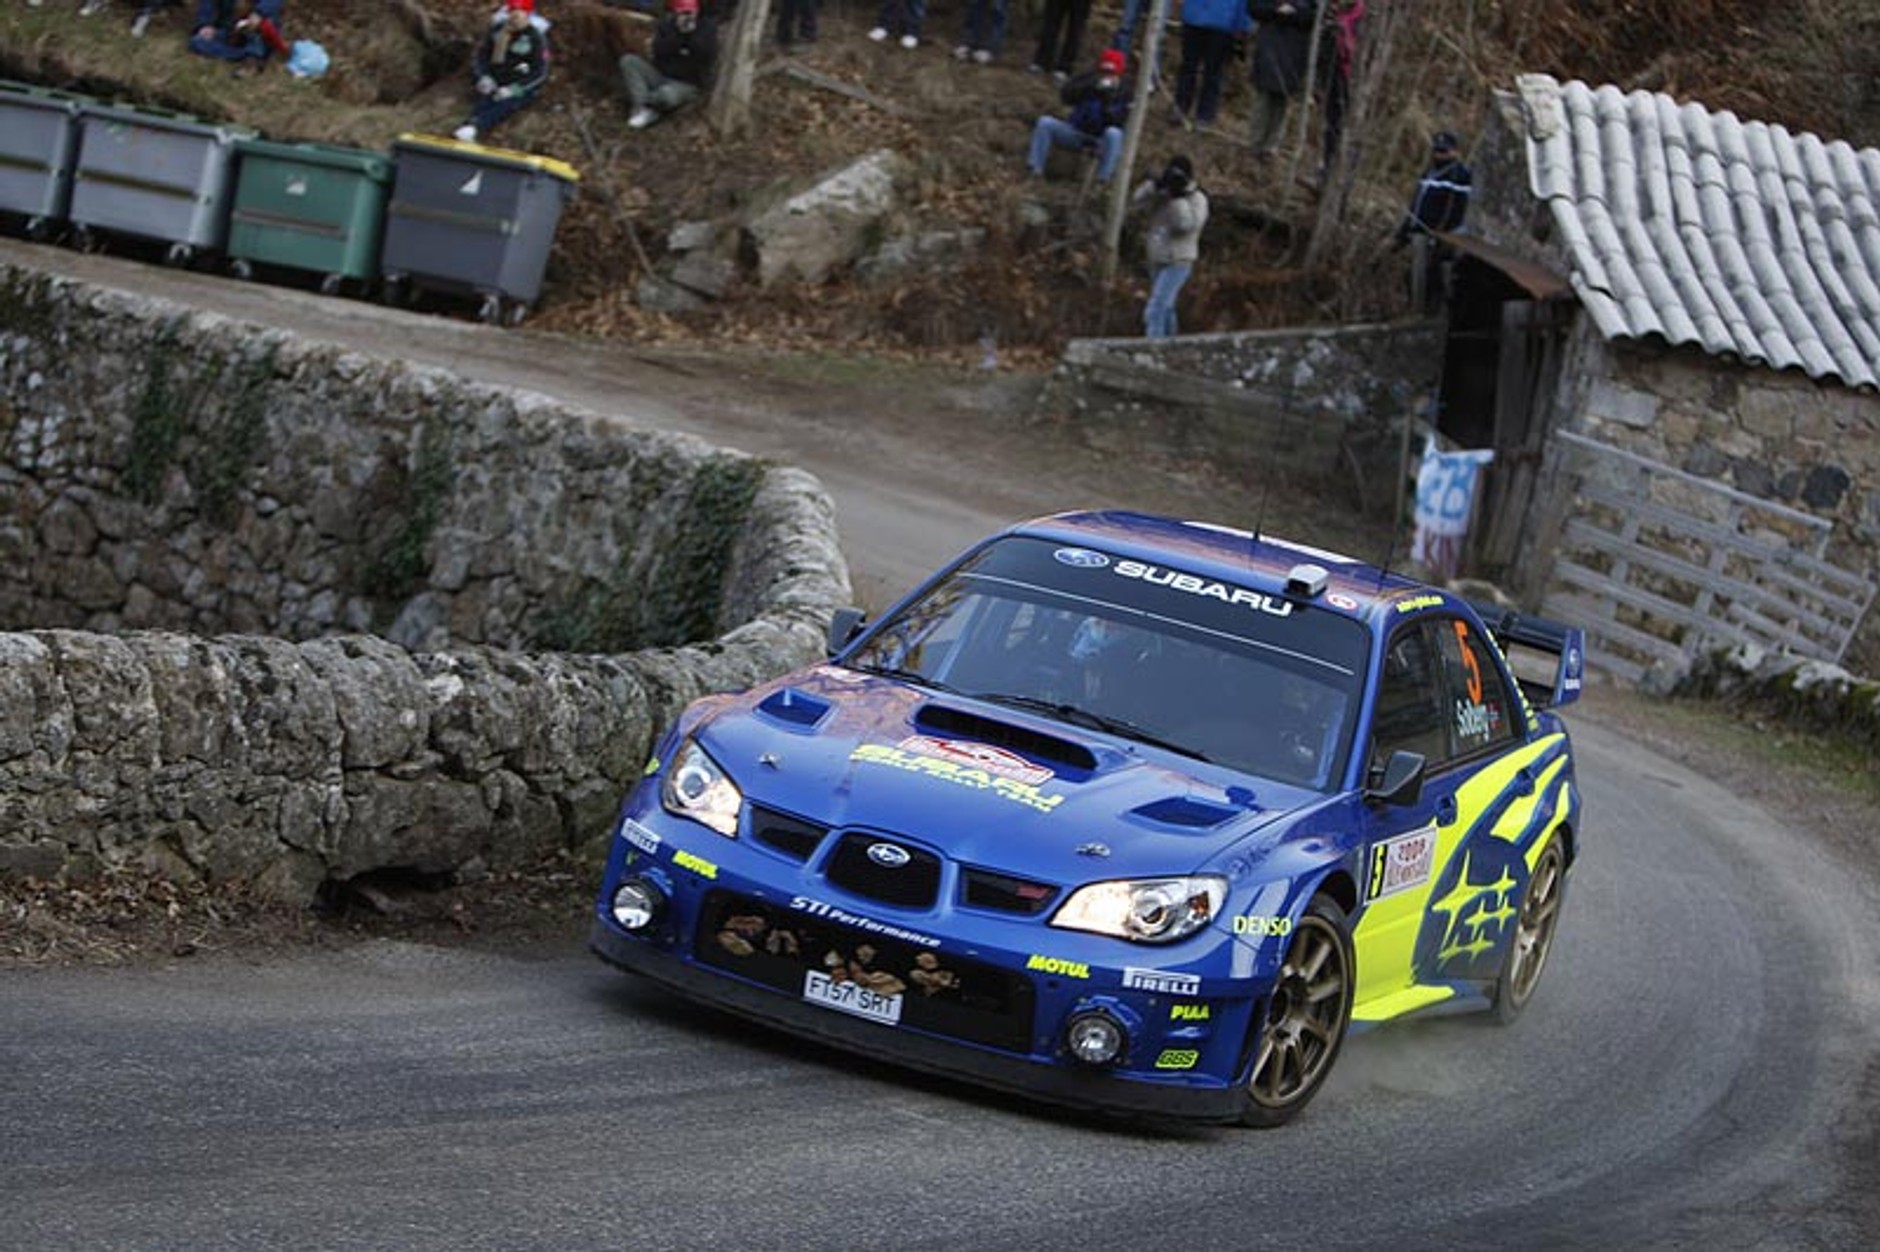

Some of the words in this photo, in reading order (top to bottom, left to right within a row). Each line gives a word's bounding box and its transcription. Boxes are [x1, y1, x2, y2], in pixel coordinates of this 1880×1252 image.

[1114, 560, 1293, 617] SUBARU
[1453, 619, 1483, 706] 5
[850, 744, 1065, 806] SUBARU
[671, 849, 718, 879] MOTUL
[789, 896, 831, 916] STI
[828, 911, 942, 948] Performance
[1233, 915, 1292, 936] DENSO
[1026, 954, 1091, 979] MOTUL
[1121, 966, 1201, 996] PIRELLI
[857, 988, 898, 1015] SRT
[1170, 1004, 1211, 1020] PIAA
